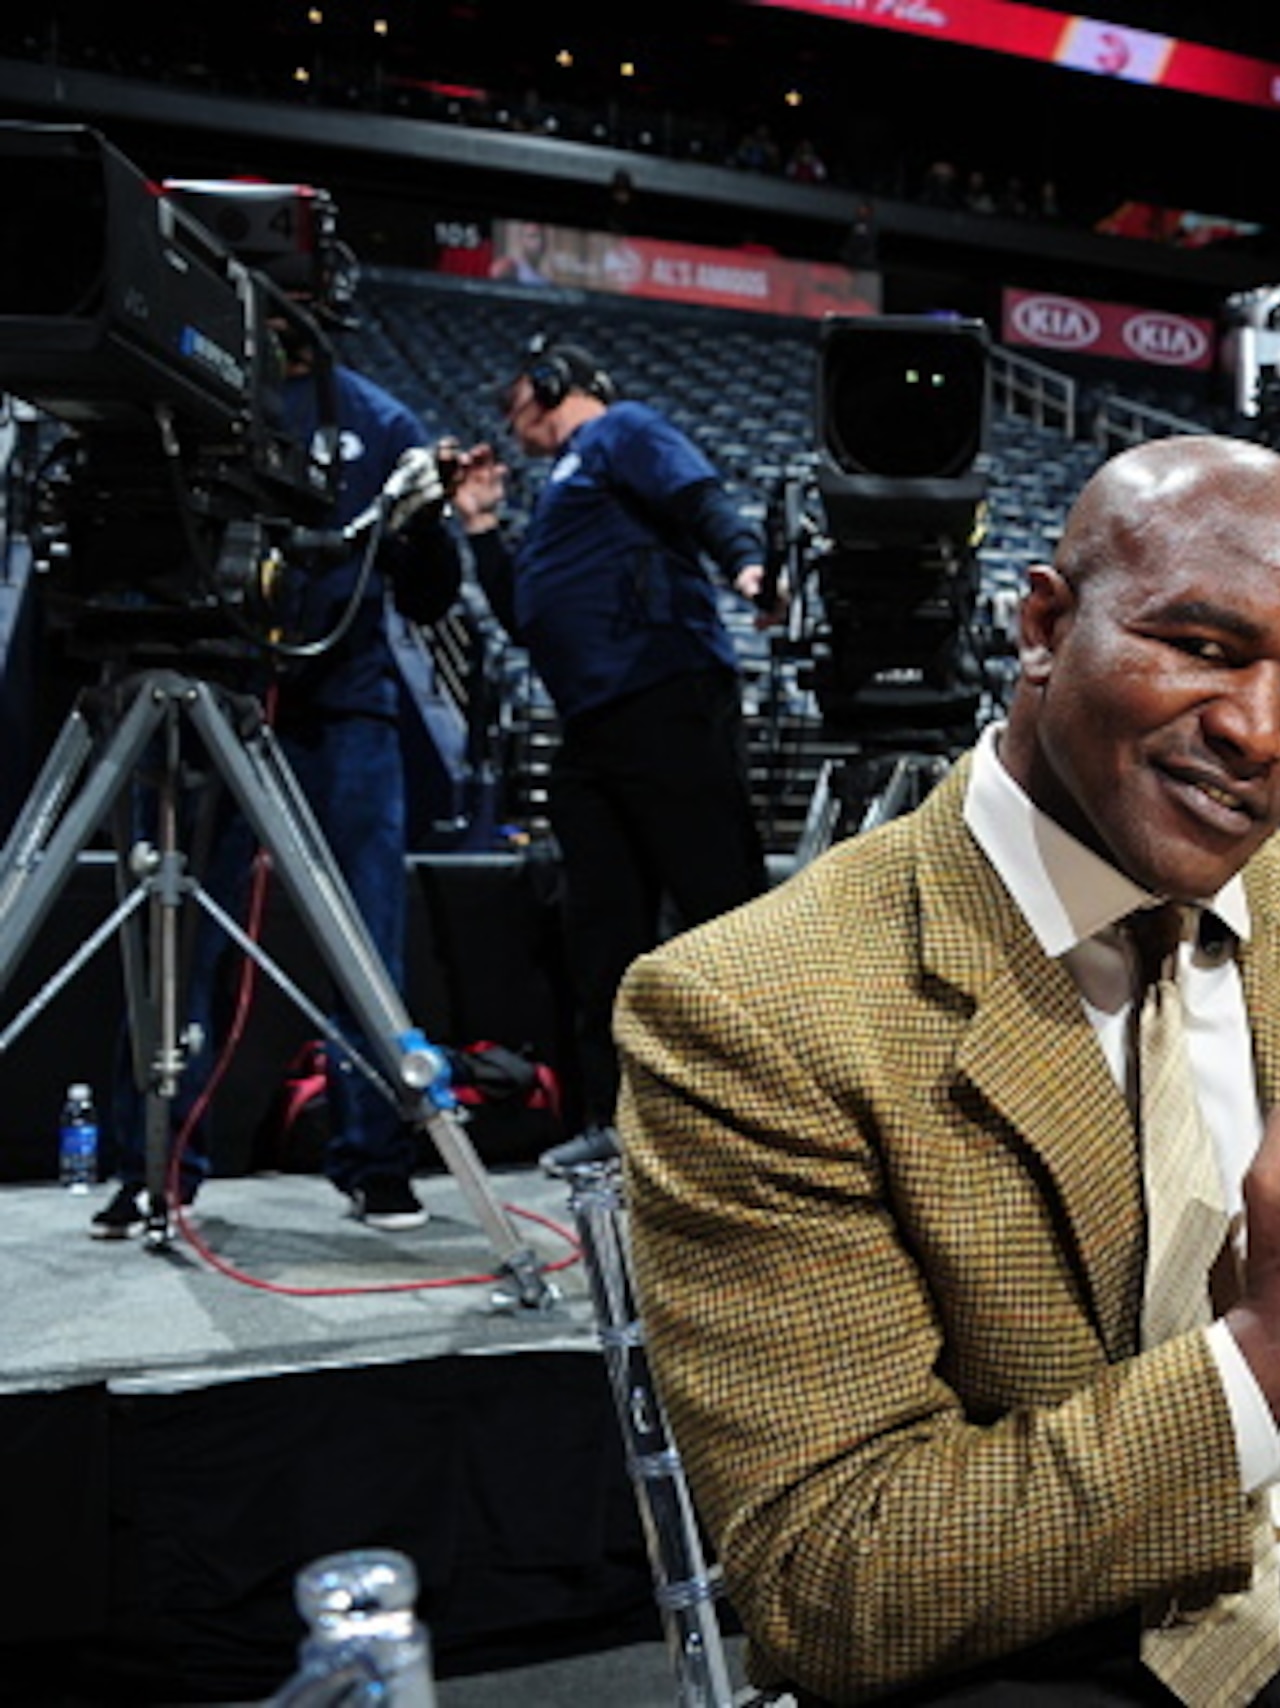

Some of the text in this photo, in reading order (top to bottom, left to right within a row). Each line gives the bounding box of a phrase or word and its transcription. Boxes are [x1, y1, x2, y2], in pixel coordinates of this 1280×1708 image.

[434, 222, 481, 247] 105
[1026, 303, 1082, 335] KIA
[1138, 318, 1191, 351] KIA
